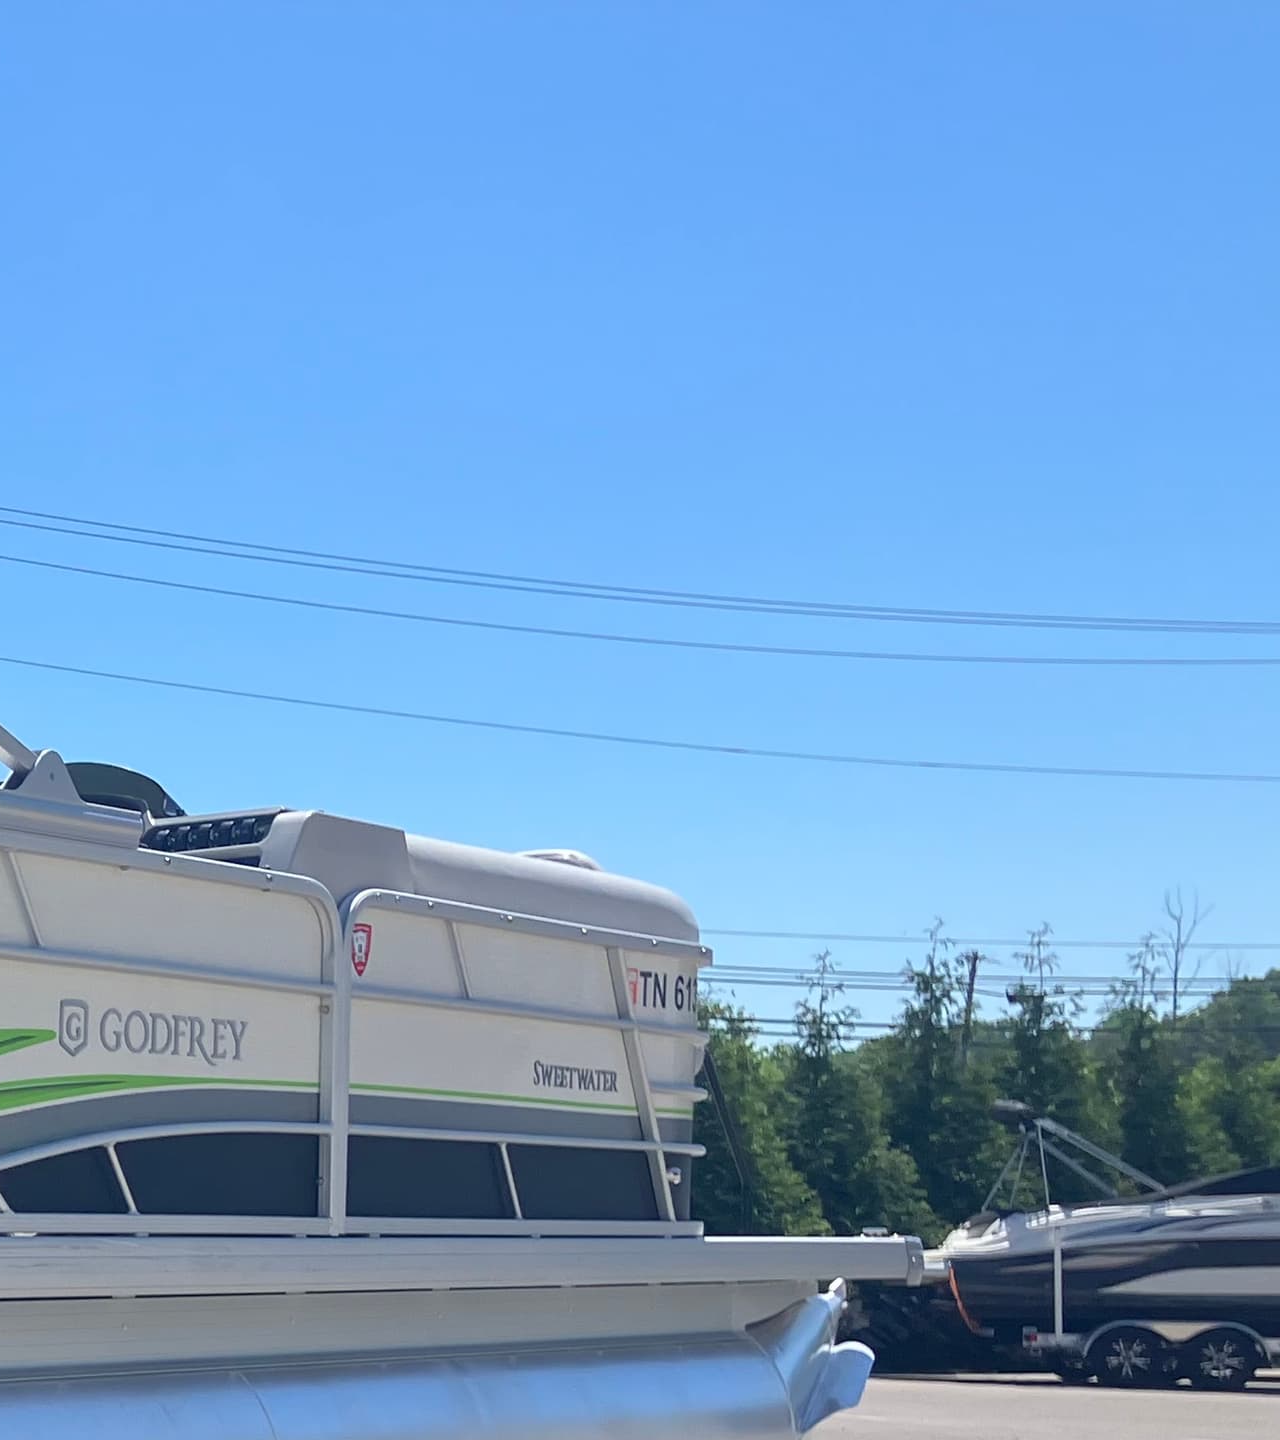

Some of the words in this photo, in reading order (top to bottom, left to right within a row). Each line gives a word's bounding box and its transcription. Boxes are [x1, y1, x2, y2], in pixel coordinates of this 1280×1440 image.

[639, 970, 667, 1009] TN
[99, 1007, 249, 1067] GODFREY
[532, 1059, 619, 1094] SWEETWATER
